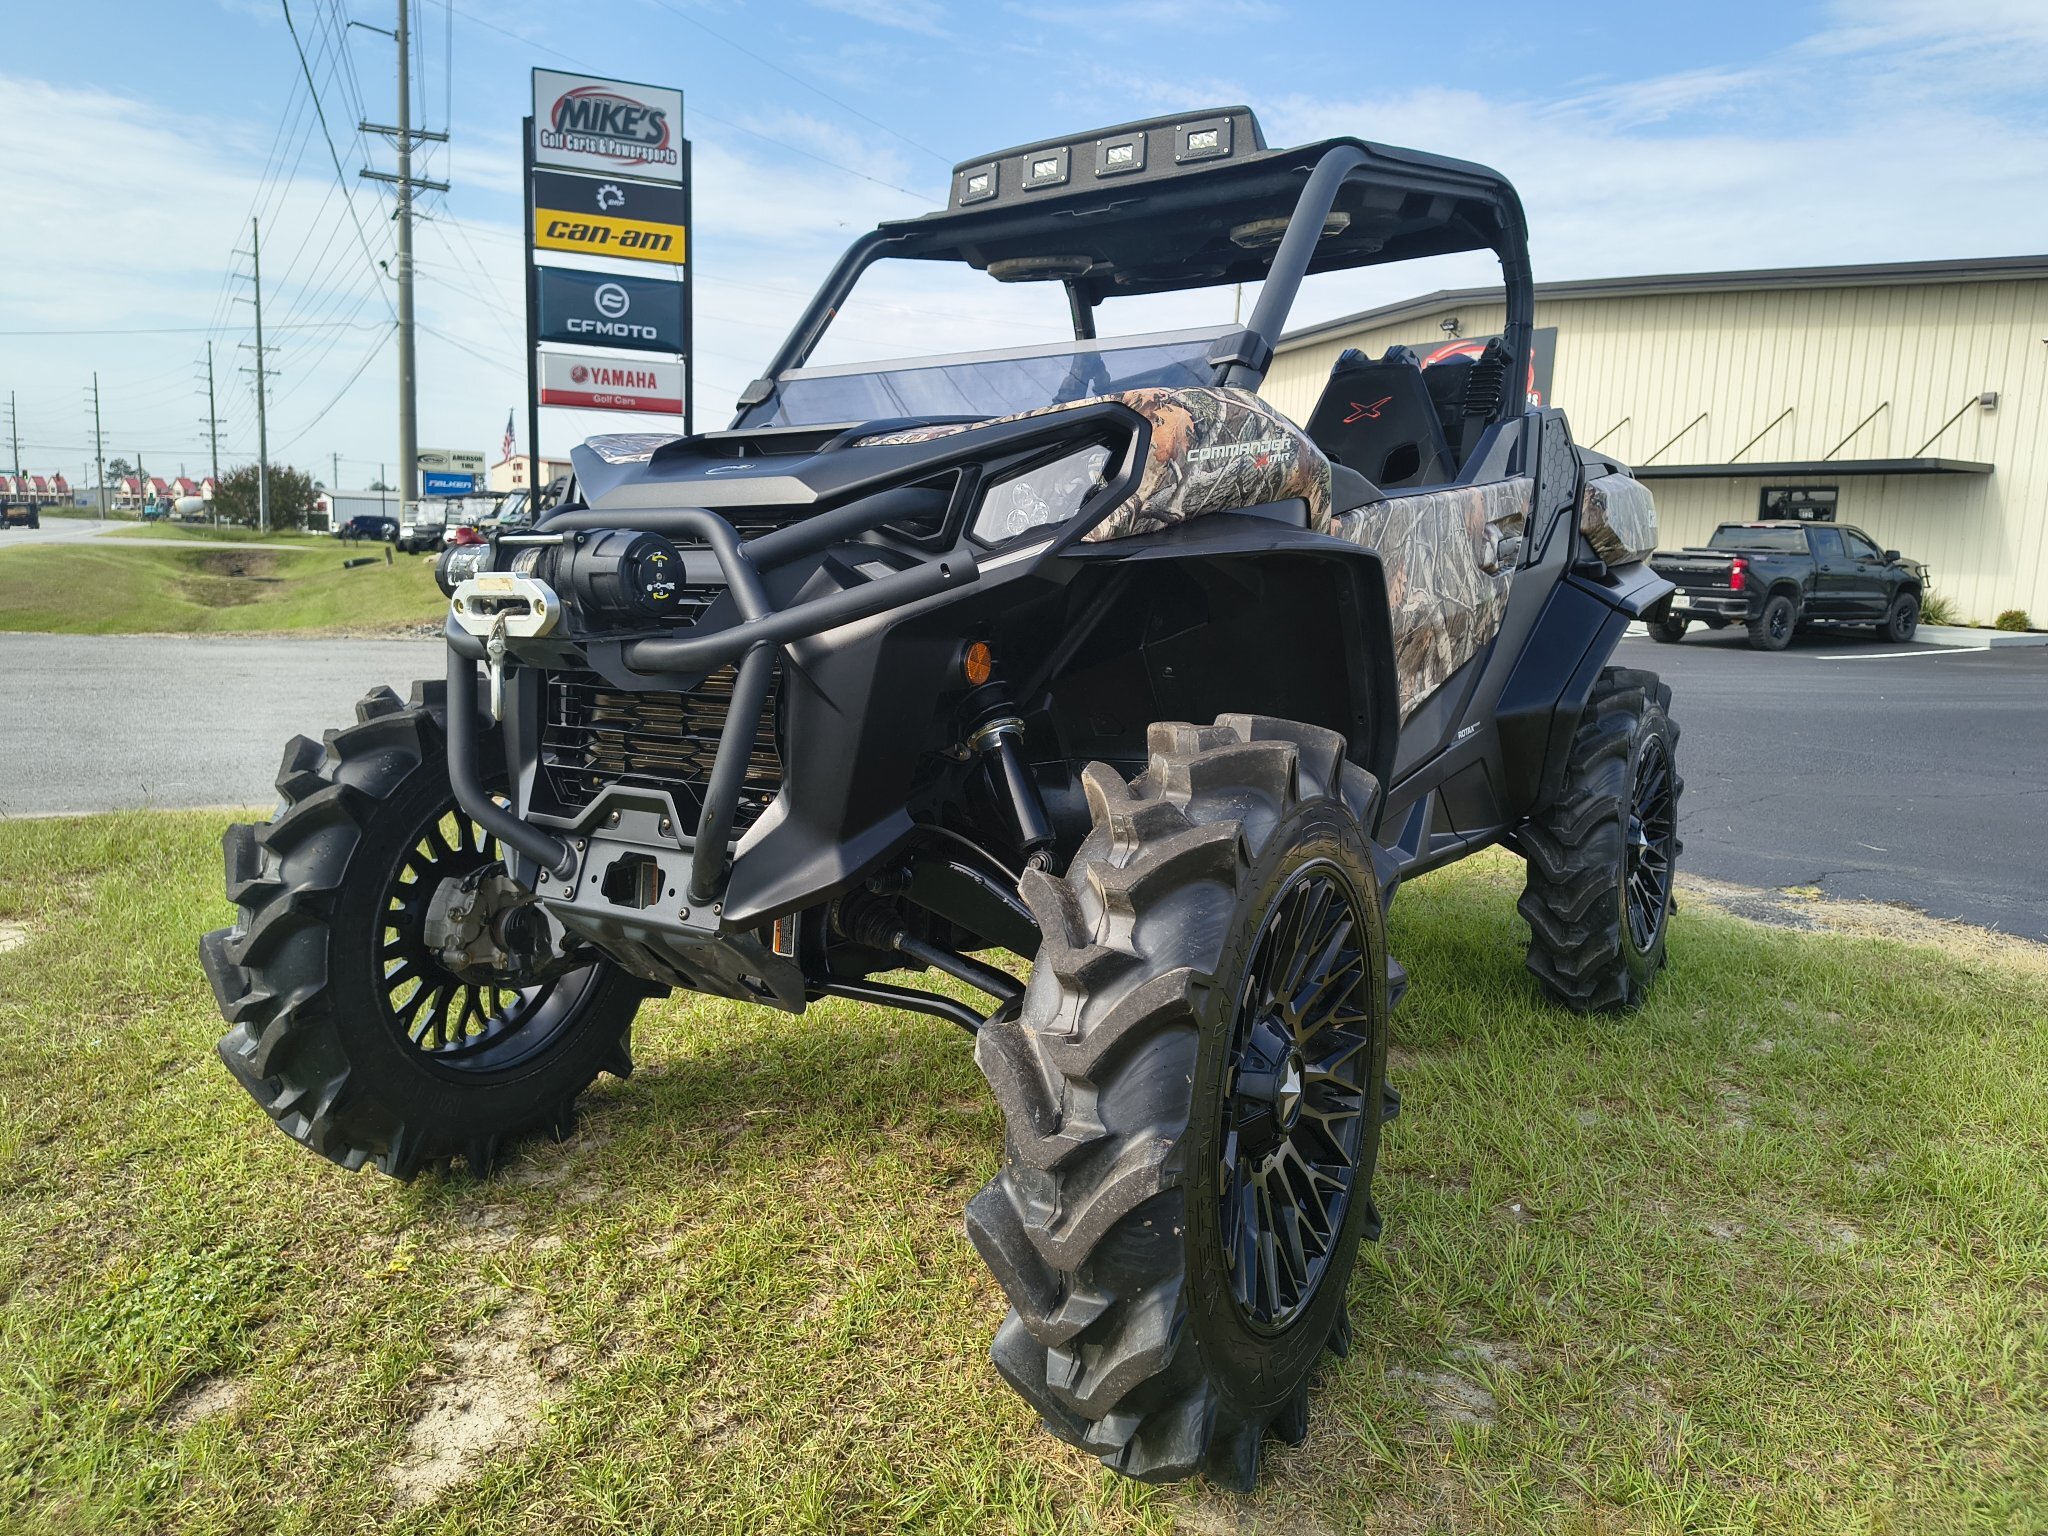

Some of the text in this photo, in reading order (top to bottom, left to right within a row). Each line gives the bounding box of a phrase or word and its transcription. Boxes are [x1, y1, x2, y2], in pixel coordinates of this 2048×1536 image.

[556, 96, 666, 145] MIKE'S
[541, 129, 677, 165] Golf Carts & Powersports
[546, 220, 673, 251] can-am
[567, 318, 657, 339] CFMOTO
[590, 367, 657, 389] YAMAHA
[593, 393, 636, 406] Golf Cars
[1187, 437, 1291, 462] COMMANDER
[428, 479, 472, 488] FALKEN
[1458, 726, 1475, 739] ROTAX
